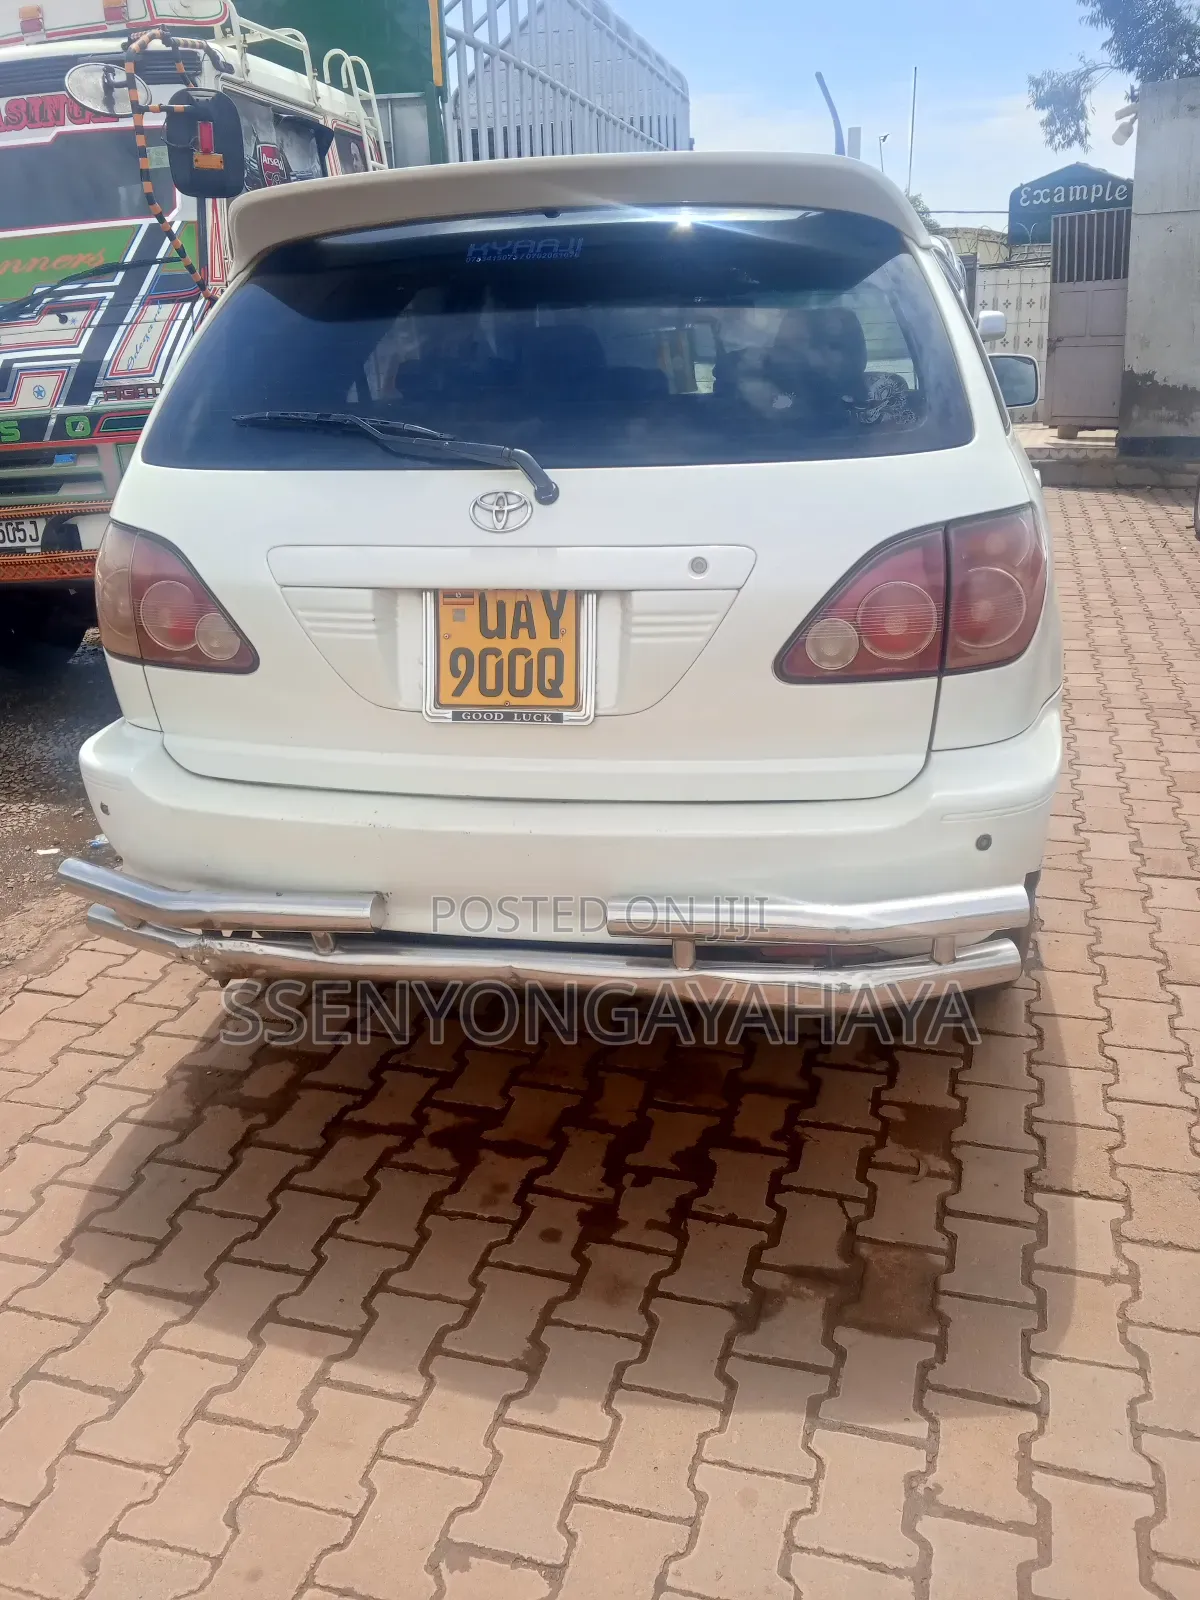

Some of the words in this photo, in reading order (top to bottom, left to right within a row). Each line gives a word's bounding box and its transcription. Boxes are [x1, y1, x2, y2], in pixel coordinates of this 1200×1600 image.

[1020, 181, 1128, 206] Example
[478, 589, 567, 639] UAY
[449, 647, 565, 698] 900Q
[461, 712, 504, 722] GOOD
[513, 712, 553, 722] LUCK
